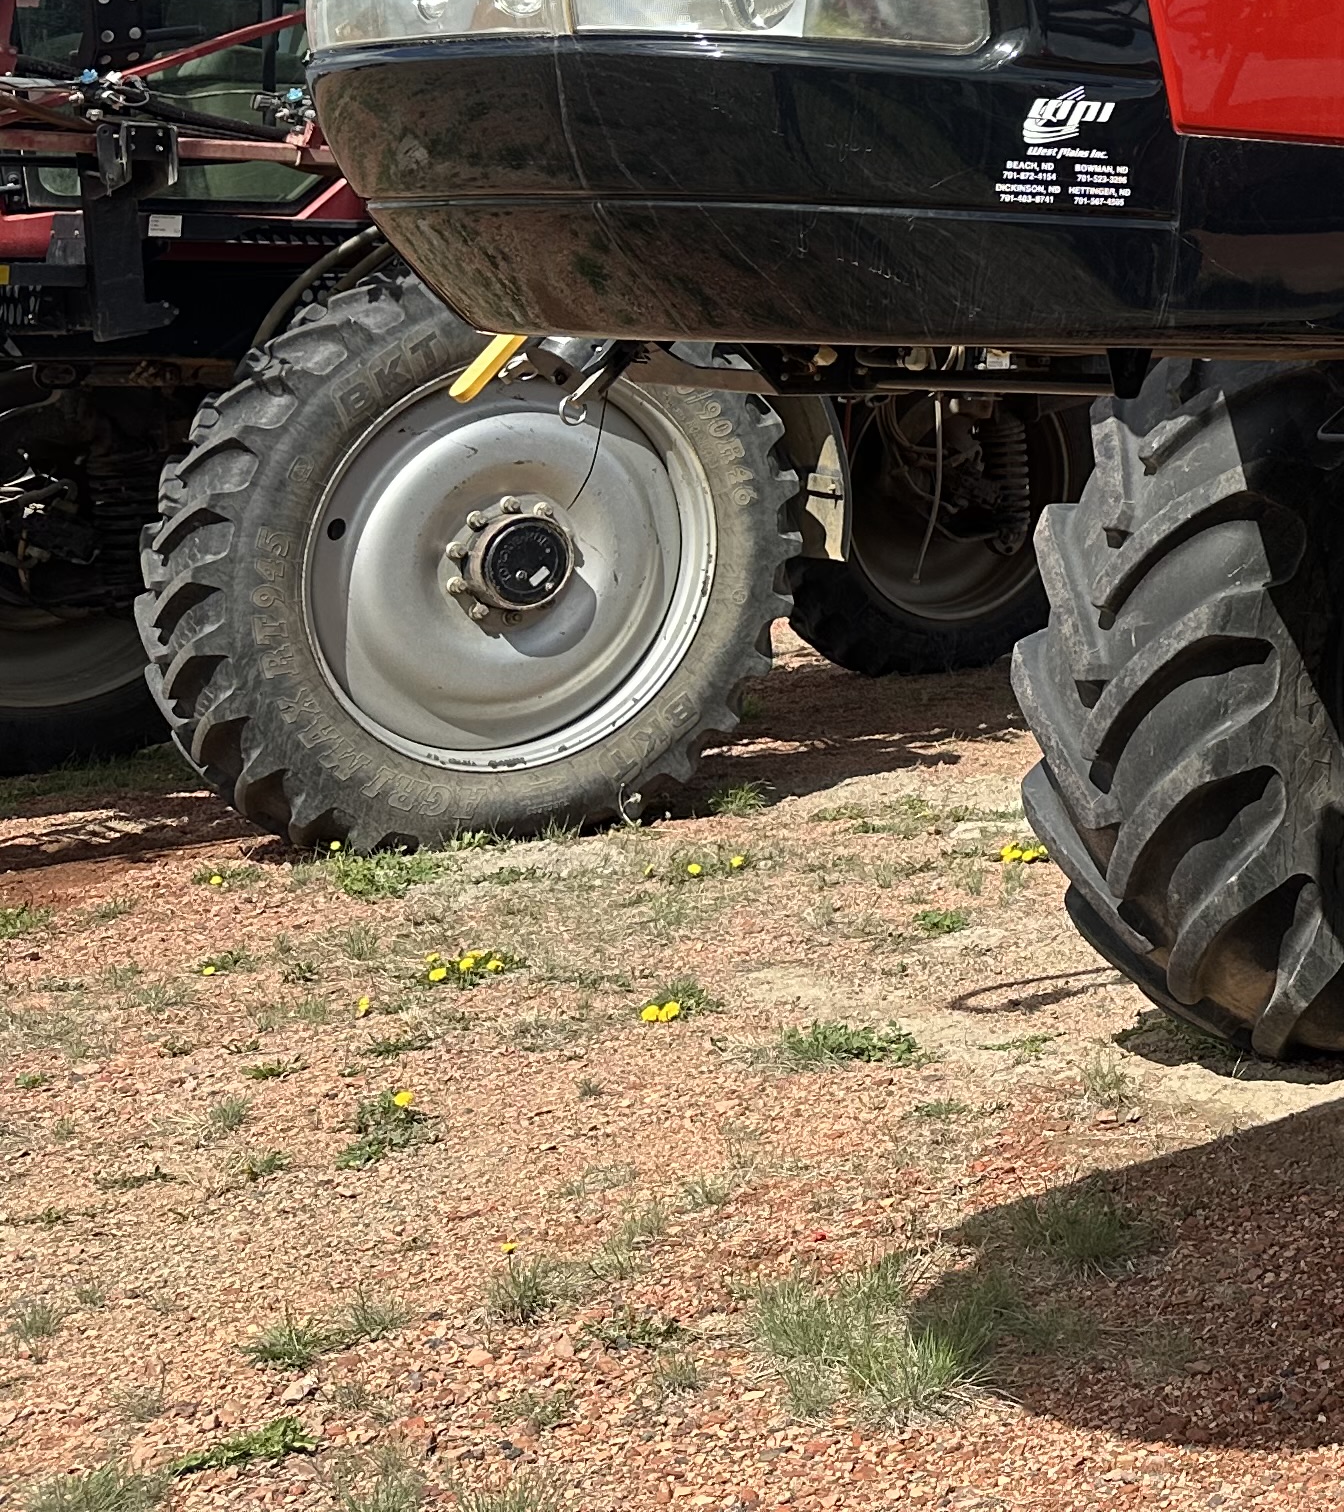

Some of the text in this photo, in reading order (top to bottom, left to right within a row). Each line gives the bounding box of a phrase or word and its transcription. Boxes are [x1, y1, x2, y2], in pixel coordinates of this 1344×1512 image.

[1026, 146, 1109, 160] West Plains Inc.
[1041, 162, 1055, 171] ND
[1116, 165, 1129, 174] ND
[1048, 185, 1061, 193] ND
[1119, 188, 1131, 196] ND
[335, 329, 440, 423] BKT
